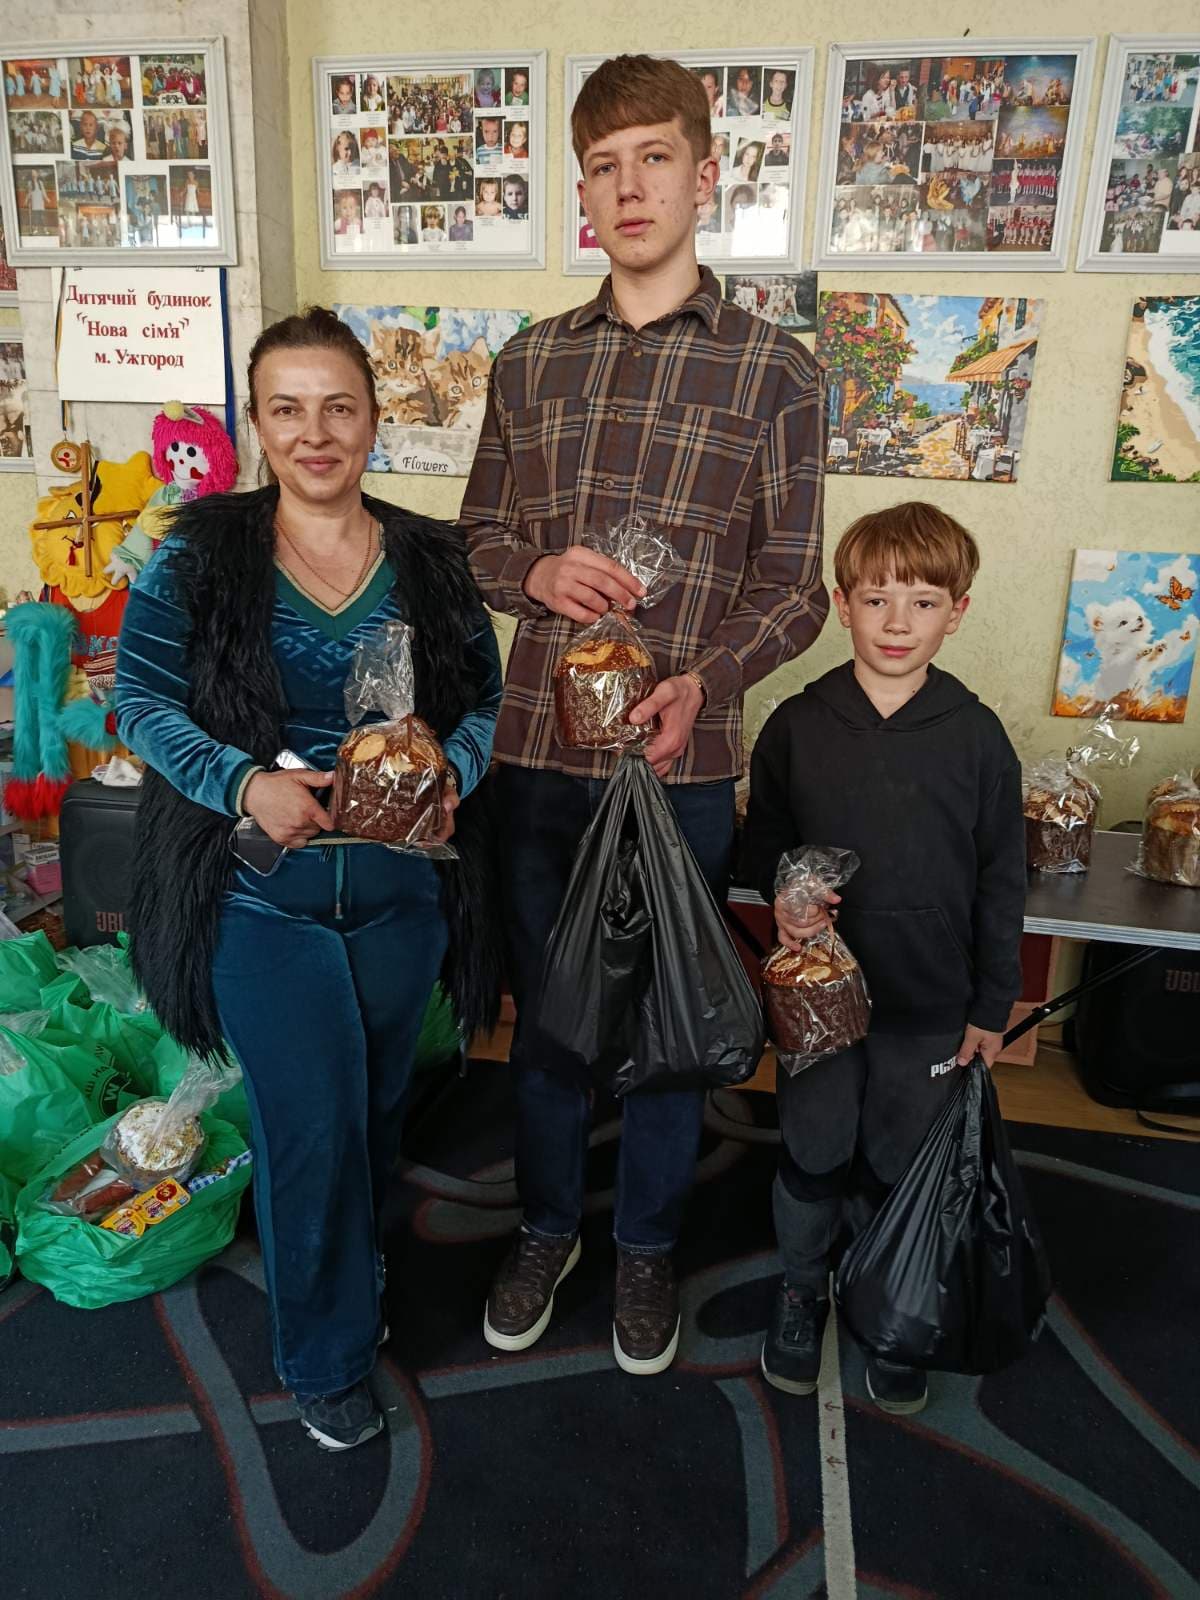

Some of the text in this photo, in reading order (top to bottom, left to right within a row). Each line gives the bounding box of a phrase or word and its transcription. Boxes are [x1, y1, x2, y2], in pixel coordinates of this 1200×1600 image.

[66, 284, 137, 306] Дитячий
[95, 349, 184, 370] м. Ужгород
[402, 456, 449, 473] Flowers
